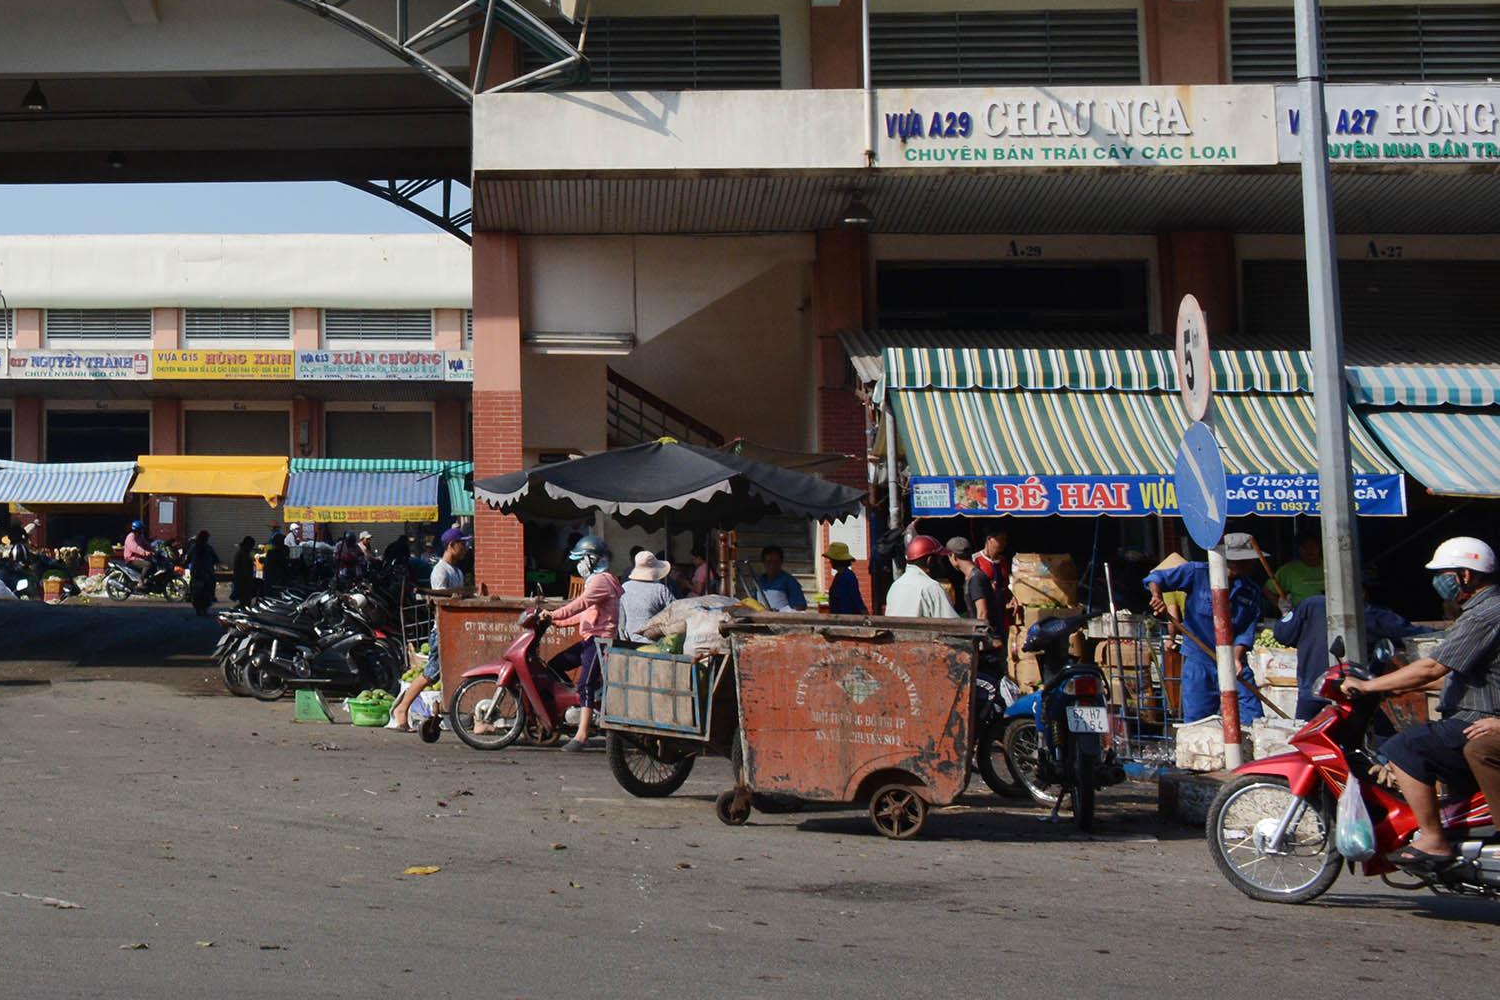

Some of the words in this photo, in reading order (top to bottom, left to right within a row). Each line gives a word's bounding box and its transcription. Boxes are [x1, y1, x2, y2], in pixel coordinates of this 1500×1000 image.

[885, 108, 925, 144] VỰA
[928, 111, 974, 139] A29
[1106, 98, 1194, 138] NGA
[1335, 109, 1379, 136] A27
[1385, 87, 1499, 136] HỒNG
[905, 145, 987, 161] CHUYÊN
[993, 144, 1034, 160] BÁN
[1041, 143, 1087, 160] TRÁI
[1093, 143, 1134, 160] CÂY
[1141, 143, 1184, 160] CÁC
[1190, 146, 1237, 162] LOẠI
[1328, 140, 1374, 159] UYÊN
[1382, 142, 1424, 159] MUA
[1428, 139, 1470, 158] BÁN
[181, 353, 198, 361] G15
[254, 353, 291, 365] XINH
[1242, 475, 1319, 488] Chuyên
[993, 476, 1049, 511] BÉ
[1057, 482, 1132, 511] HAI
[1138, 478, 1178, 516] VỰA
[1226, 487, 1259, 500] CÁC
[1264, 489, 1303, 501] LOẠI
[1353, 487, 1389, 500] CÂY
